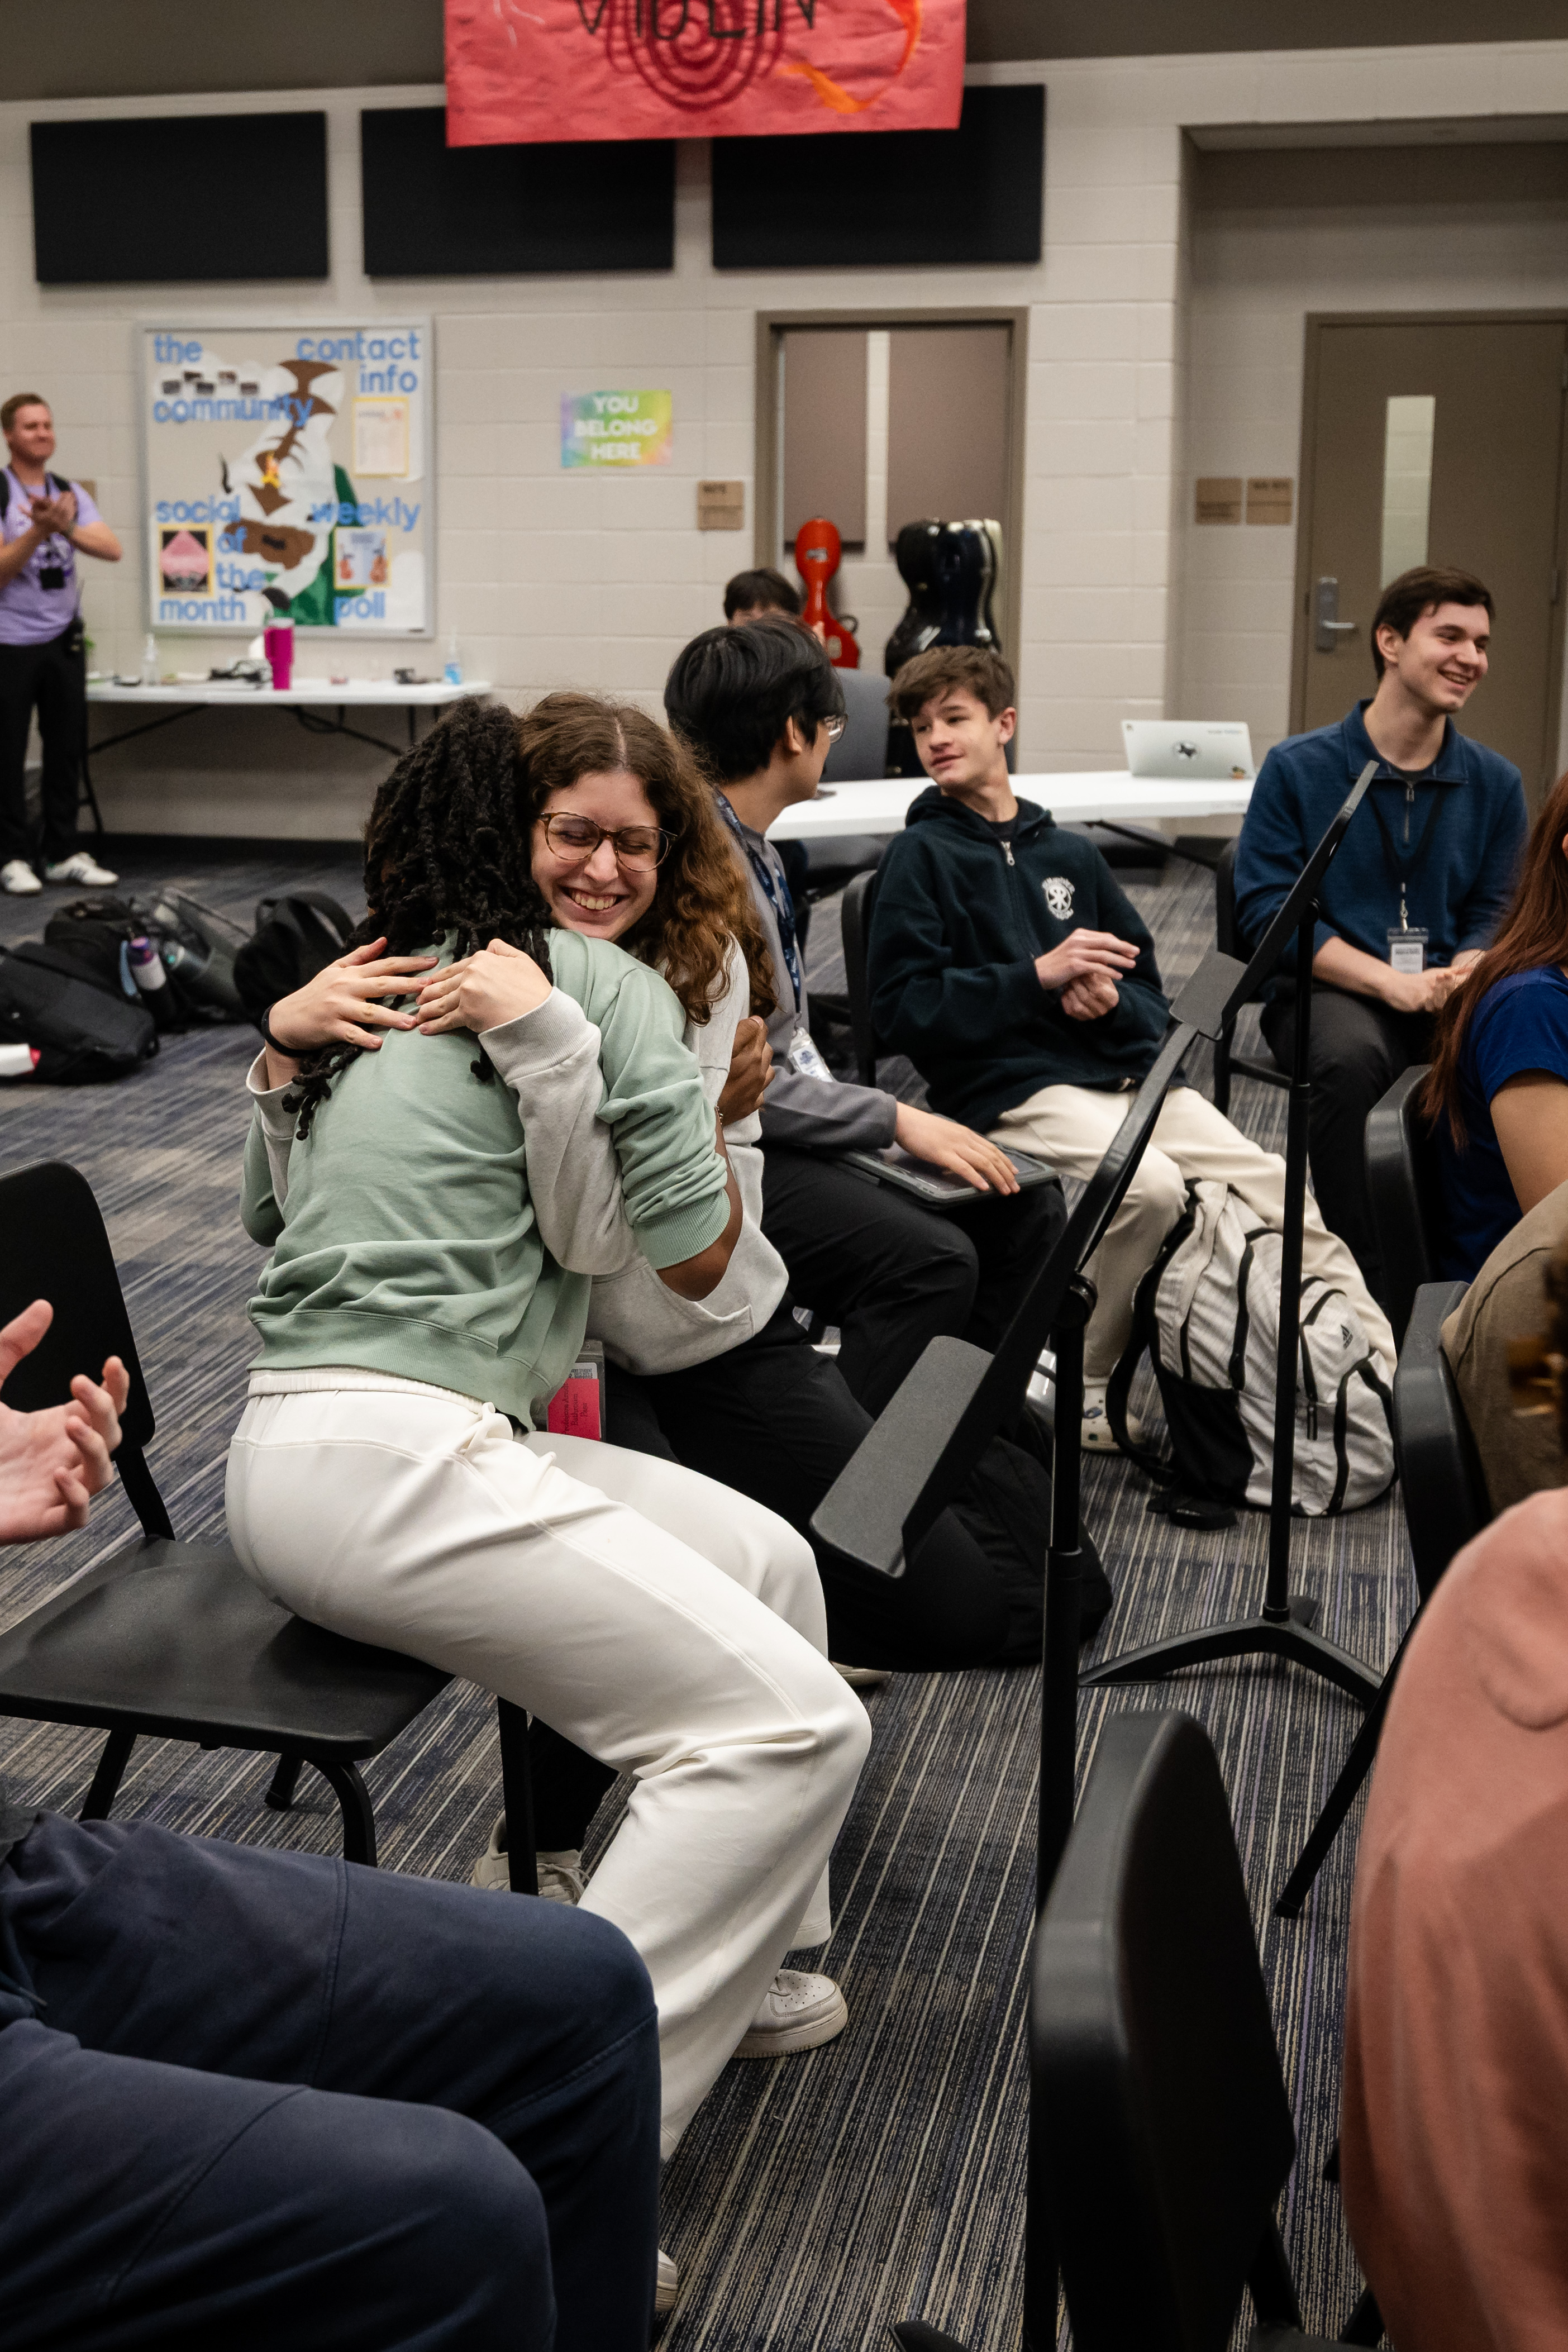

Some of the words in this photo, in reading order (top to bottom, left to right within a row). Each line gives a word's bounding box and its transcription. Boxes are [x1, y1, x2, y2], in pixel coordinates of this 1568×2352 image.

[154, 334, 203, 362] the
[296, 332, 420, 361] contact
[359, 364, 418, 393] info
[153, 393, 313, 427] community
[594, 396, 638, 413] YOU
[575, 419, 657, 436] BELONG
[591, 442, 641, 460] HERE
[156, 495, 241, 523] social
[311, 497, 420, 532] weekly
[217, 526, 247, 553] of
[216, 563, 265, 591] the
[160, 592, 245, 621] month
[334, 591, 385, 626] poll
